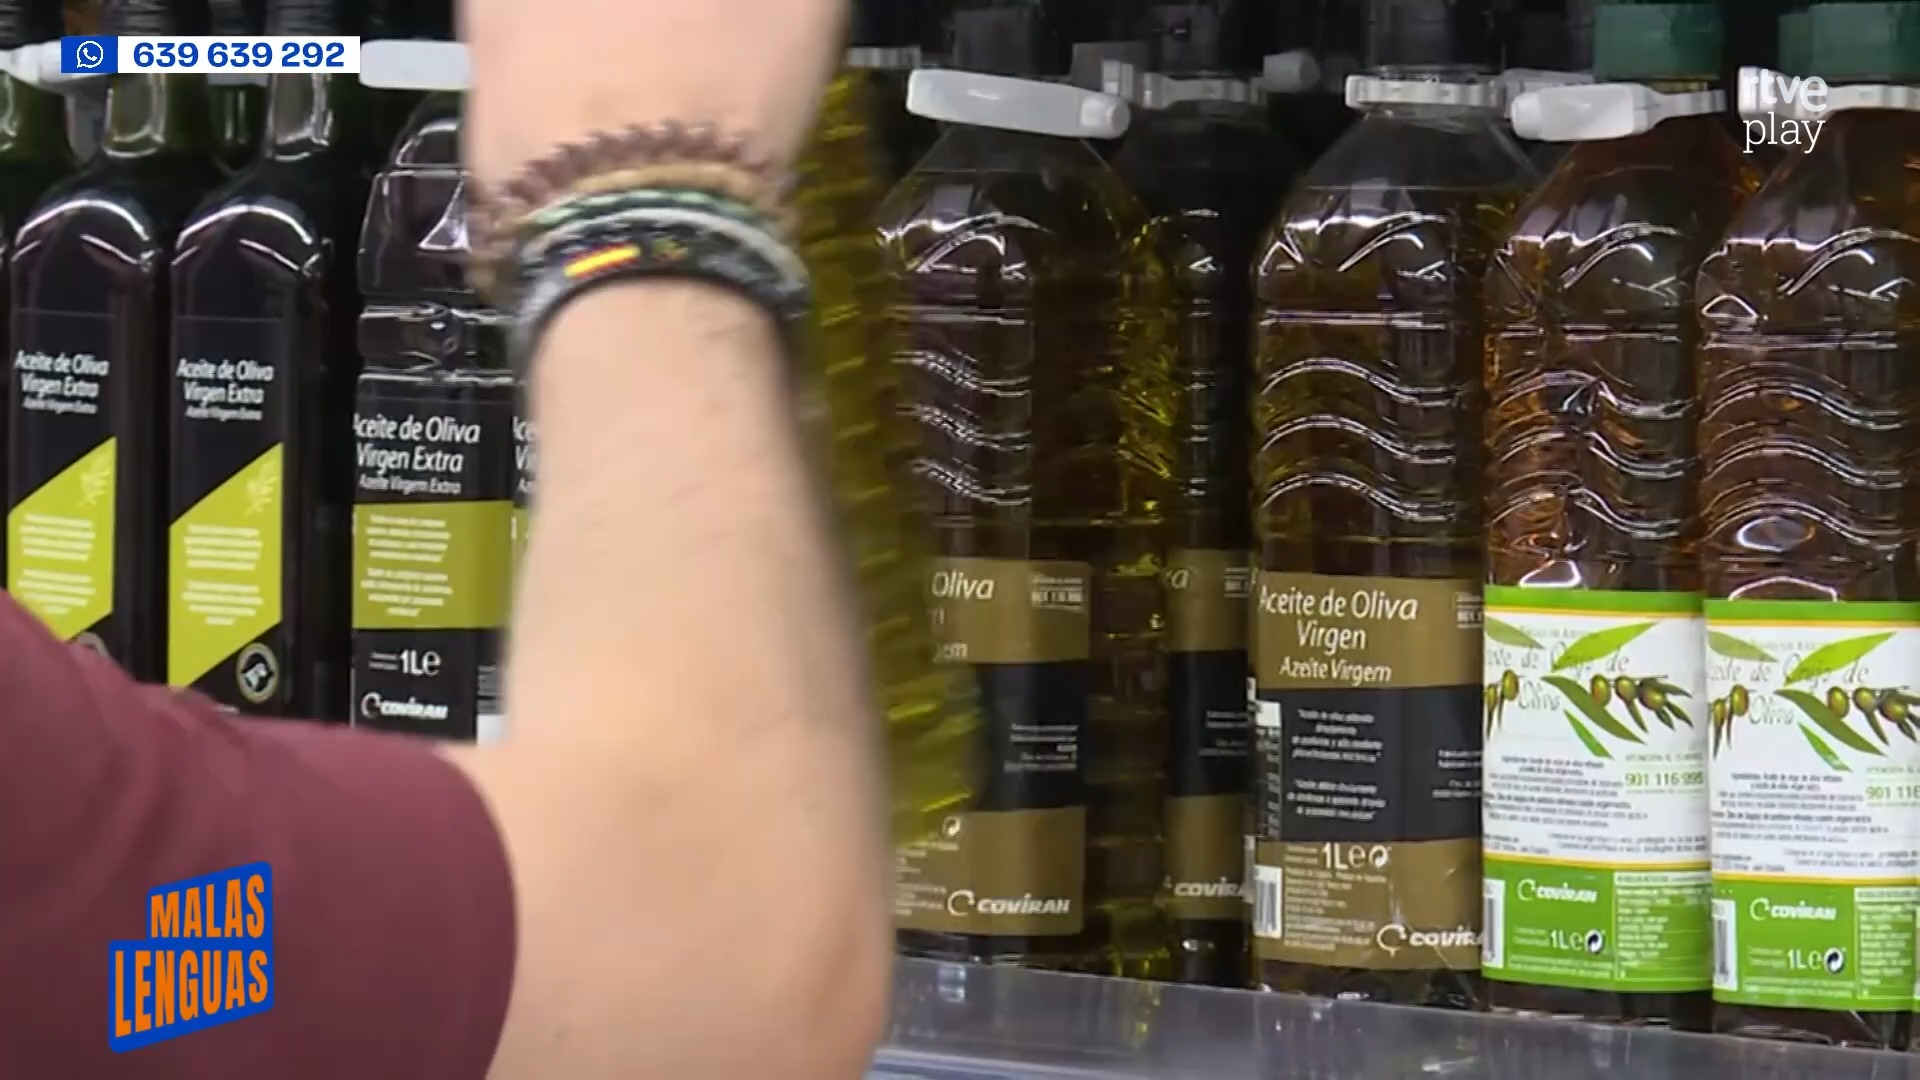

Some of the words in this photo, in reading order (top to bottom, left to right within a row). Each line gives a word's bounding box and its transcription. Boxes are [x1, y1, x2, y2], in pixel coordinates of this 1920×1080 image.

[72, 353, 110, 376] Oliva
[236, 360, 275, 381] Oliva
[399, 414, 423, 441] de
[426, 416, 481, 444] Oliva
[357, 442, 410, 475] Virgen
[412, 445, 464, 473] Extra
[931, 569, 995, 600] Oliva
[1319, 588, 1347, 617] de
[1351, 589, 1418, 620] Oliva
[1296, 619, 1367, 656] Virgen
[1279, 656, 1328, 680] Azeite
[1330, 659, 1392, 686] Virgem
